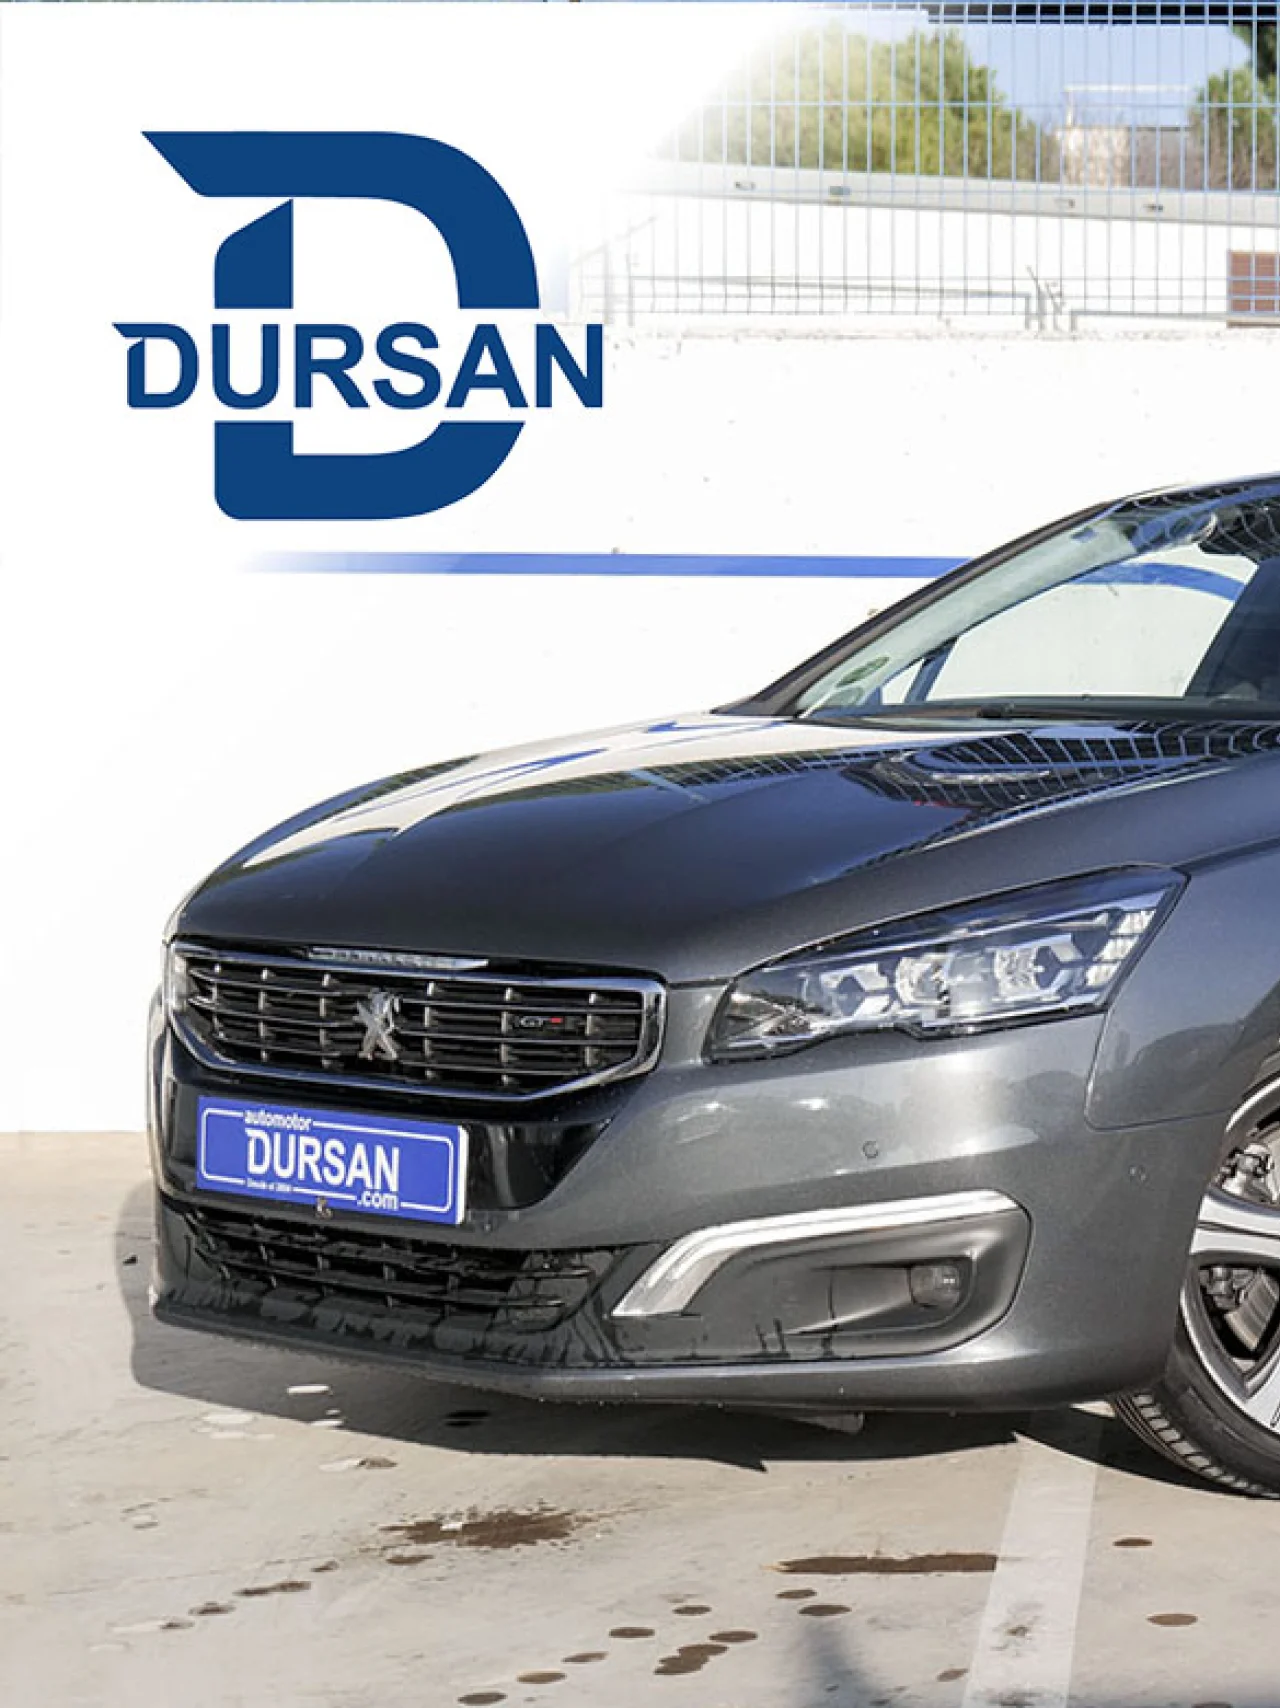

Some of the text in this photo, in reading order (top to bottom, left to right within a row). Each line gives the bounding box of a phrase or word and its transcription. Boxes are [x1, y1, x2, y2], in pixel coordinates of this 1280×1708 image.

[245, 1109, 312, 1131] automotor
[245, 1128, 399, 1192] DURSAN
[357, 1190, 398, 1211] .com
